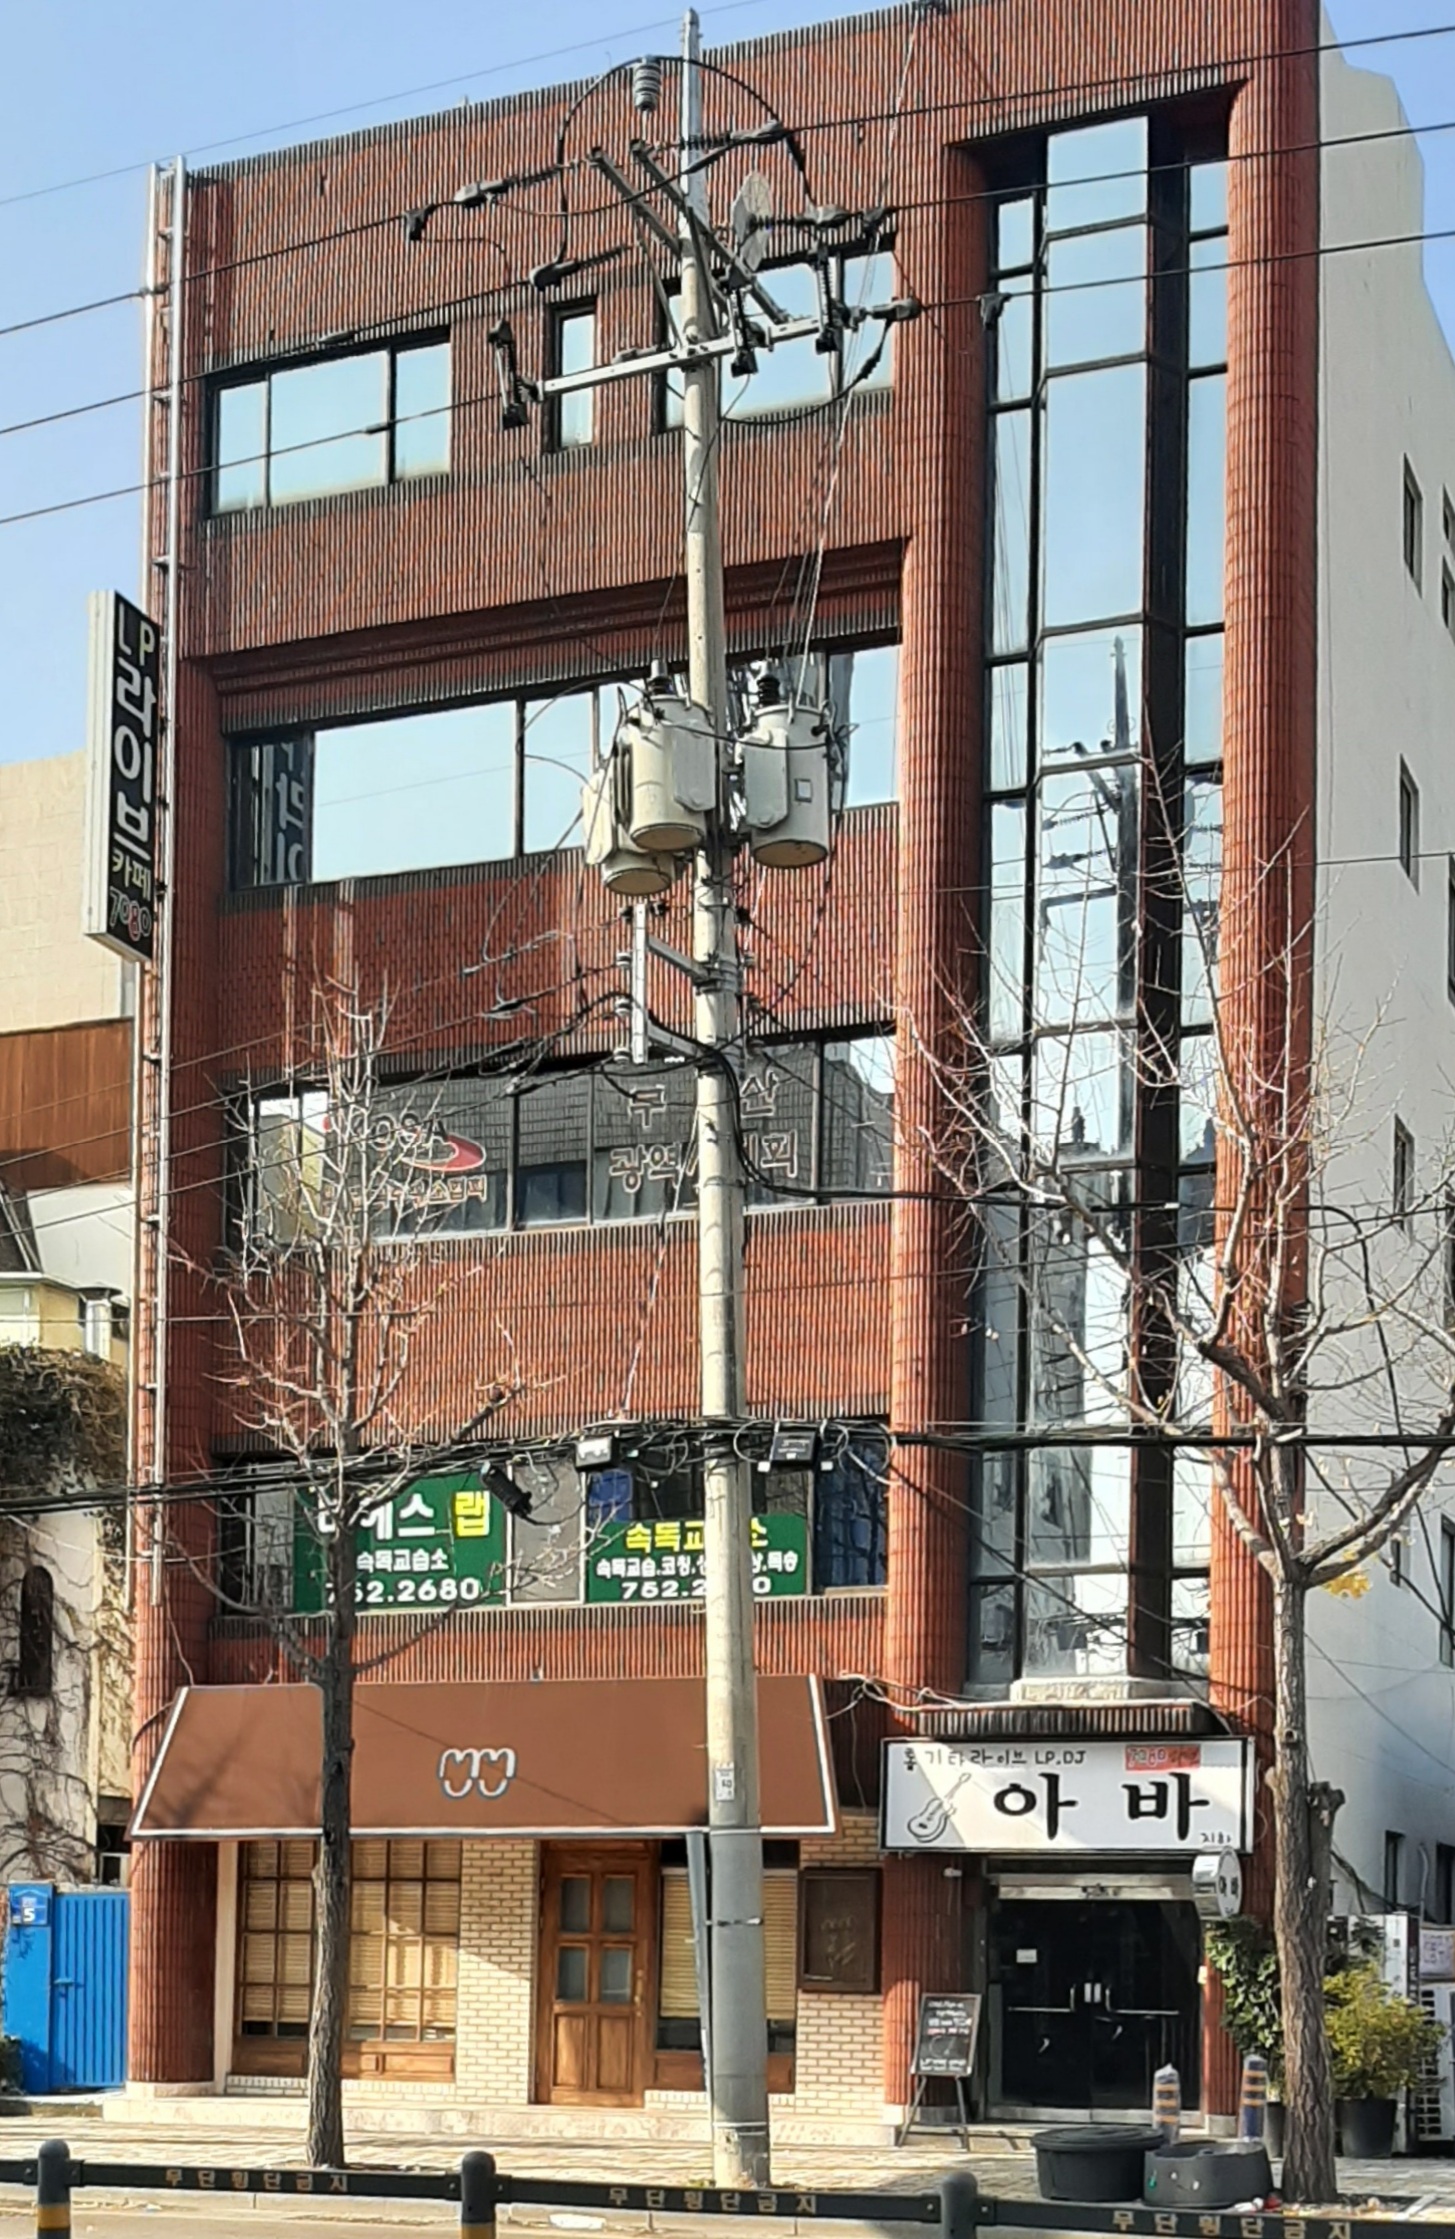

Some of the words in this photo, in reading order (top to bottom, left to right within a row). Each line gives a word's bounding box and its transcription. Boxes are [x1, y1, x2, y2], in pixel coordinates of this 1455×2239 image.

[118, 602, 157, 667] LP
[114, 656, 157, 861] 라이브
[111, 846, 151, 900] 카페
[109, 886, 152, 942] 7080
[454, 1489, 491, 1538] 랩
[625, 1517, 768, 1553] 속독교소
[356, 1547, 449, 1574] 속독교습소
[621, 1576, 772, 1600] 752.20
